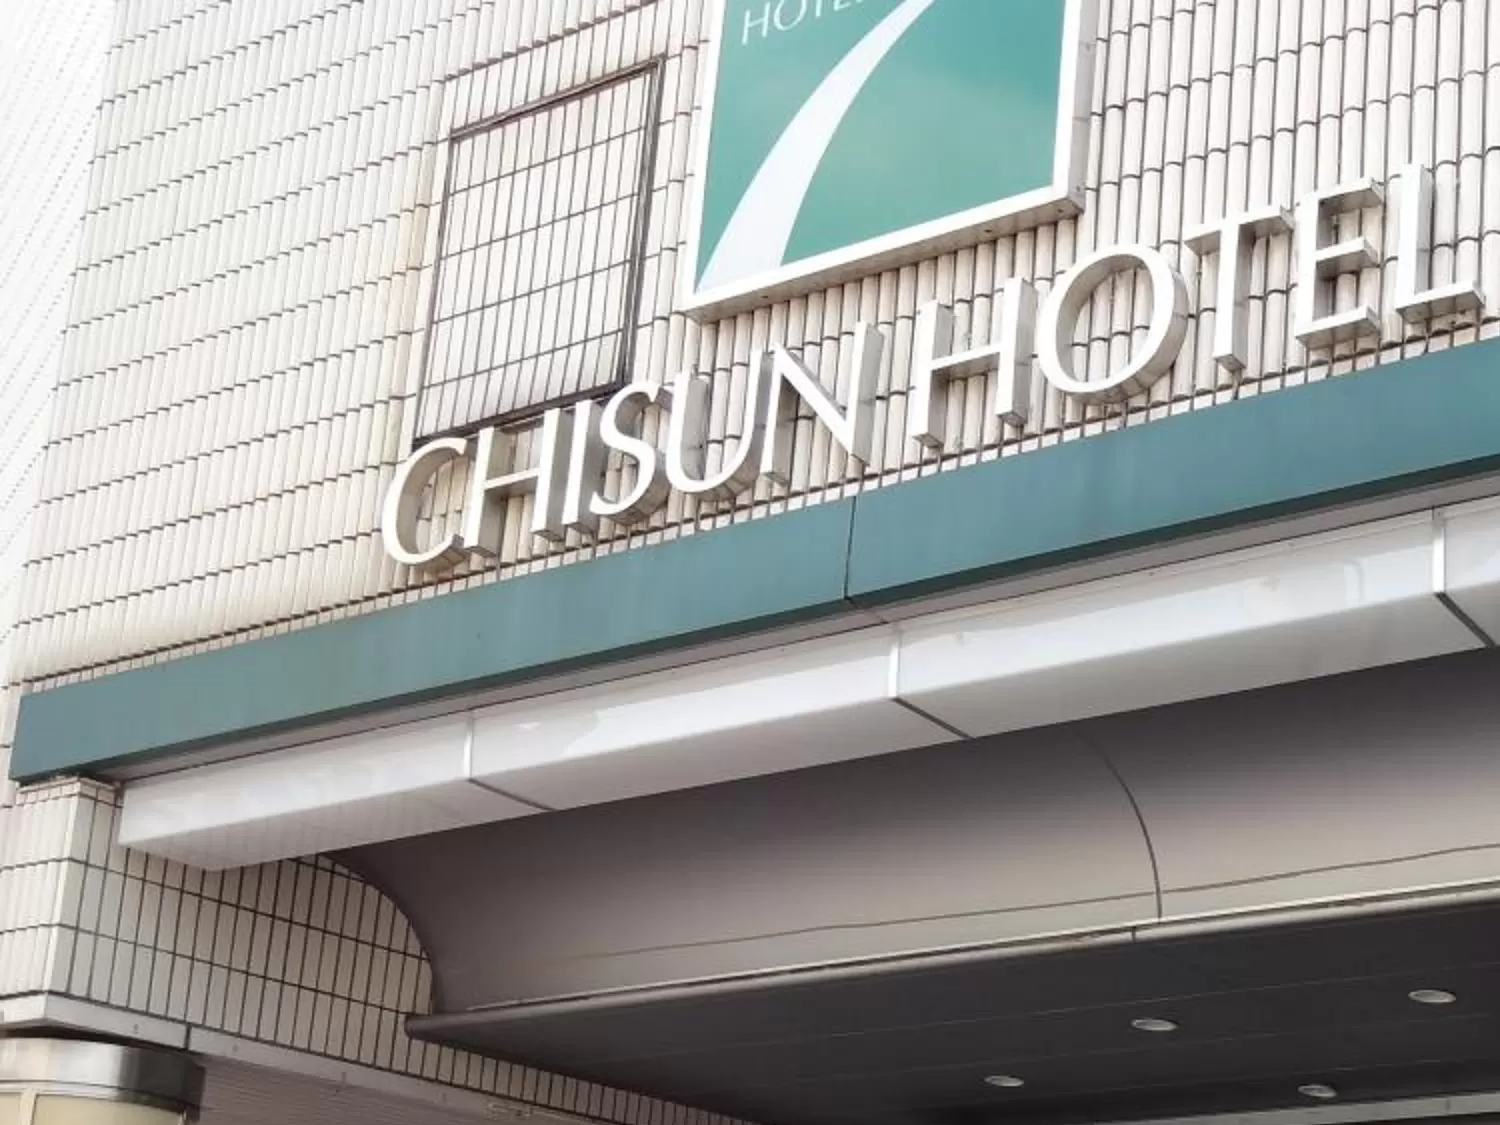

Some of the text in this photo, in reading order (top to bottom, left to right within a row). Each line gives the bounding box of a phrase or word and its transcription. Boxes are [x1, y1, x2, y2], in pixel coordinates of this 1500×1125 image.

[741, 0, 864, 45] HOT
[381, 164, 1483, 567] CHISUN HOTEL
